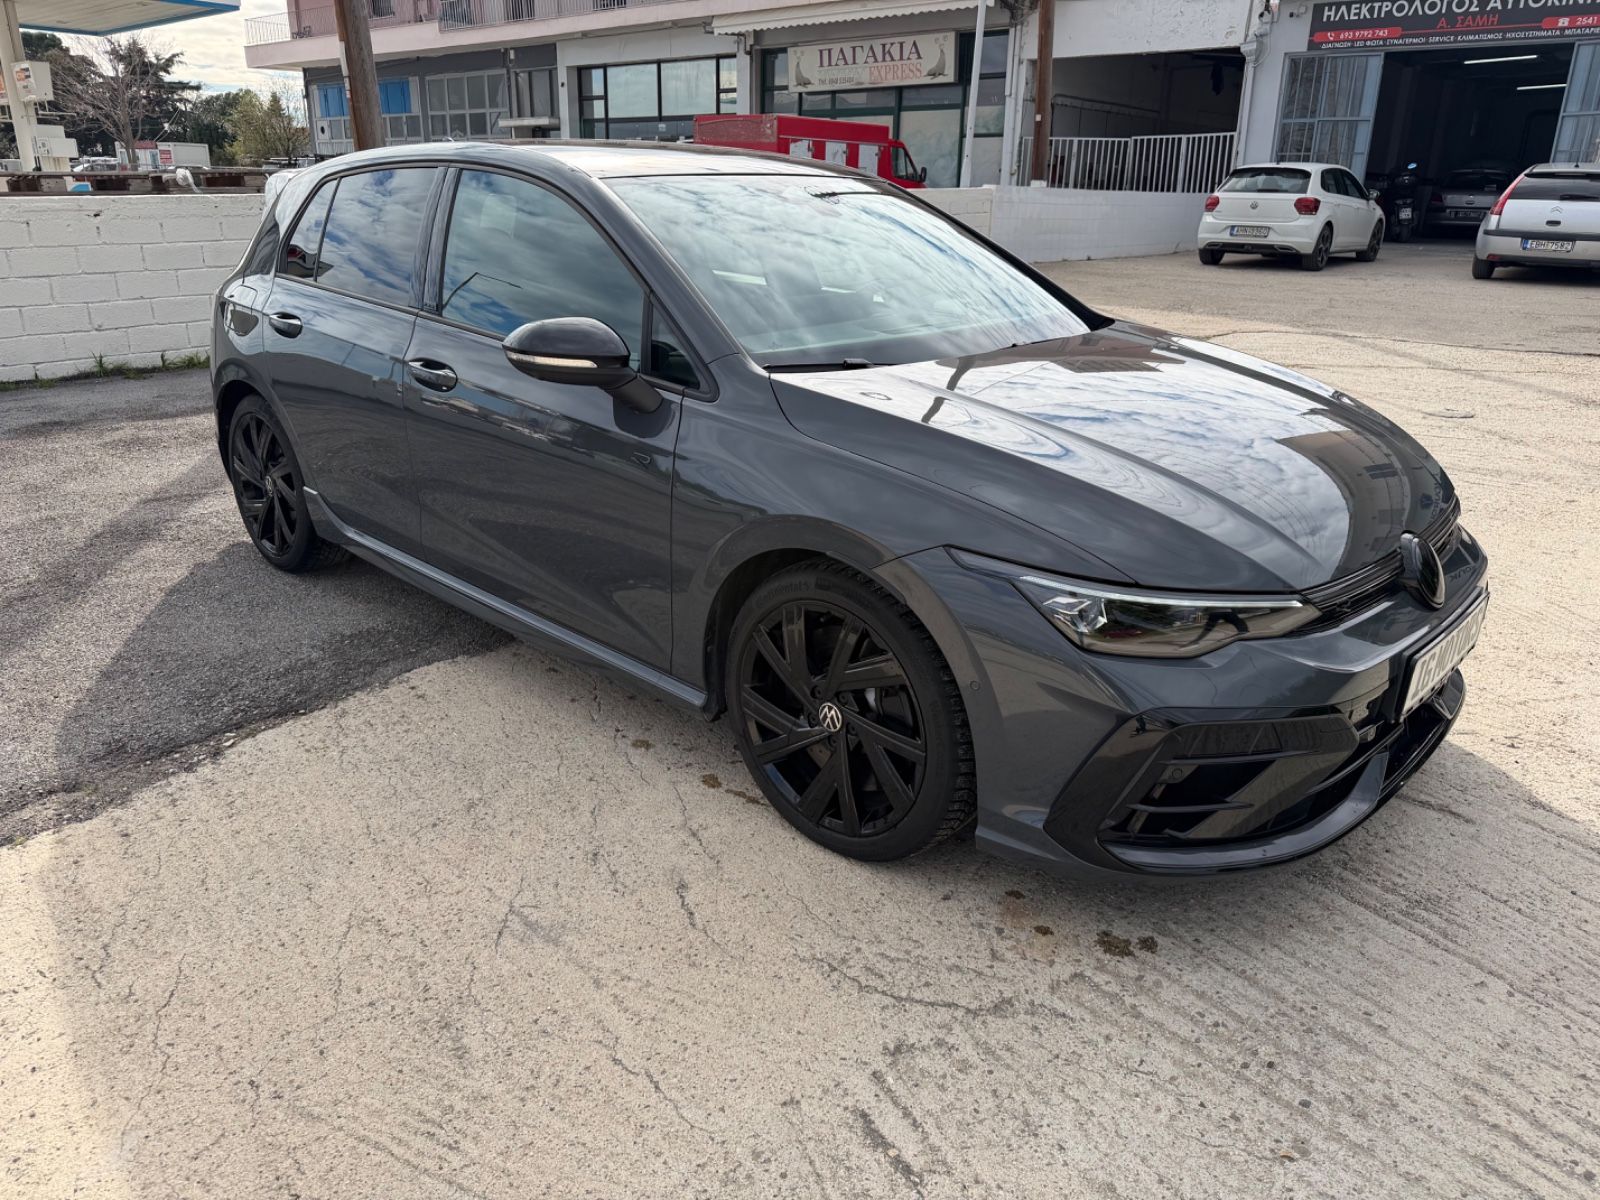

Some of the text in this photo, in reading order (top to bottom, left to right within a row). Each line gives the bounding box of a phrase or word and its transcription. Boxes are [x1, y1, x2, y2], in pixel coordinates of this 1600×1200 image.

[1455, 13, 1499, 27] ΣΑΜΗ
[1429, 35, 1455, 43] SERVICE
[817, 39, 923, 68] ΠΑΓΑΚΙΑ
[868, 62, 922, 82] EXPRESS
